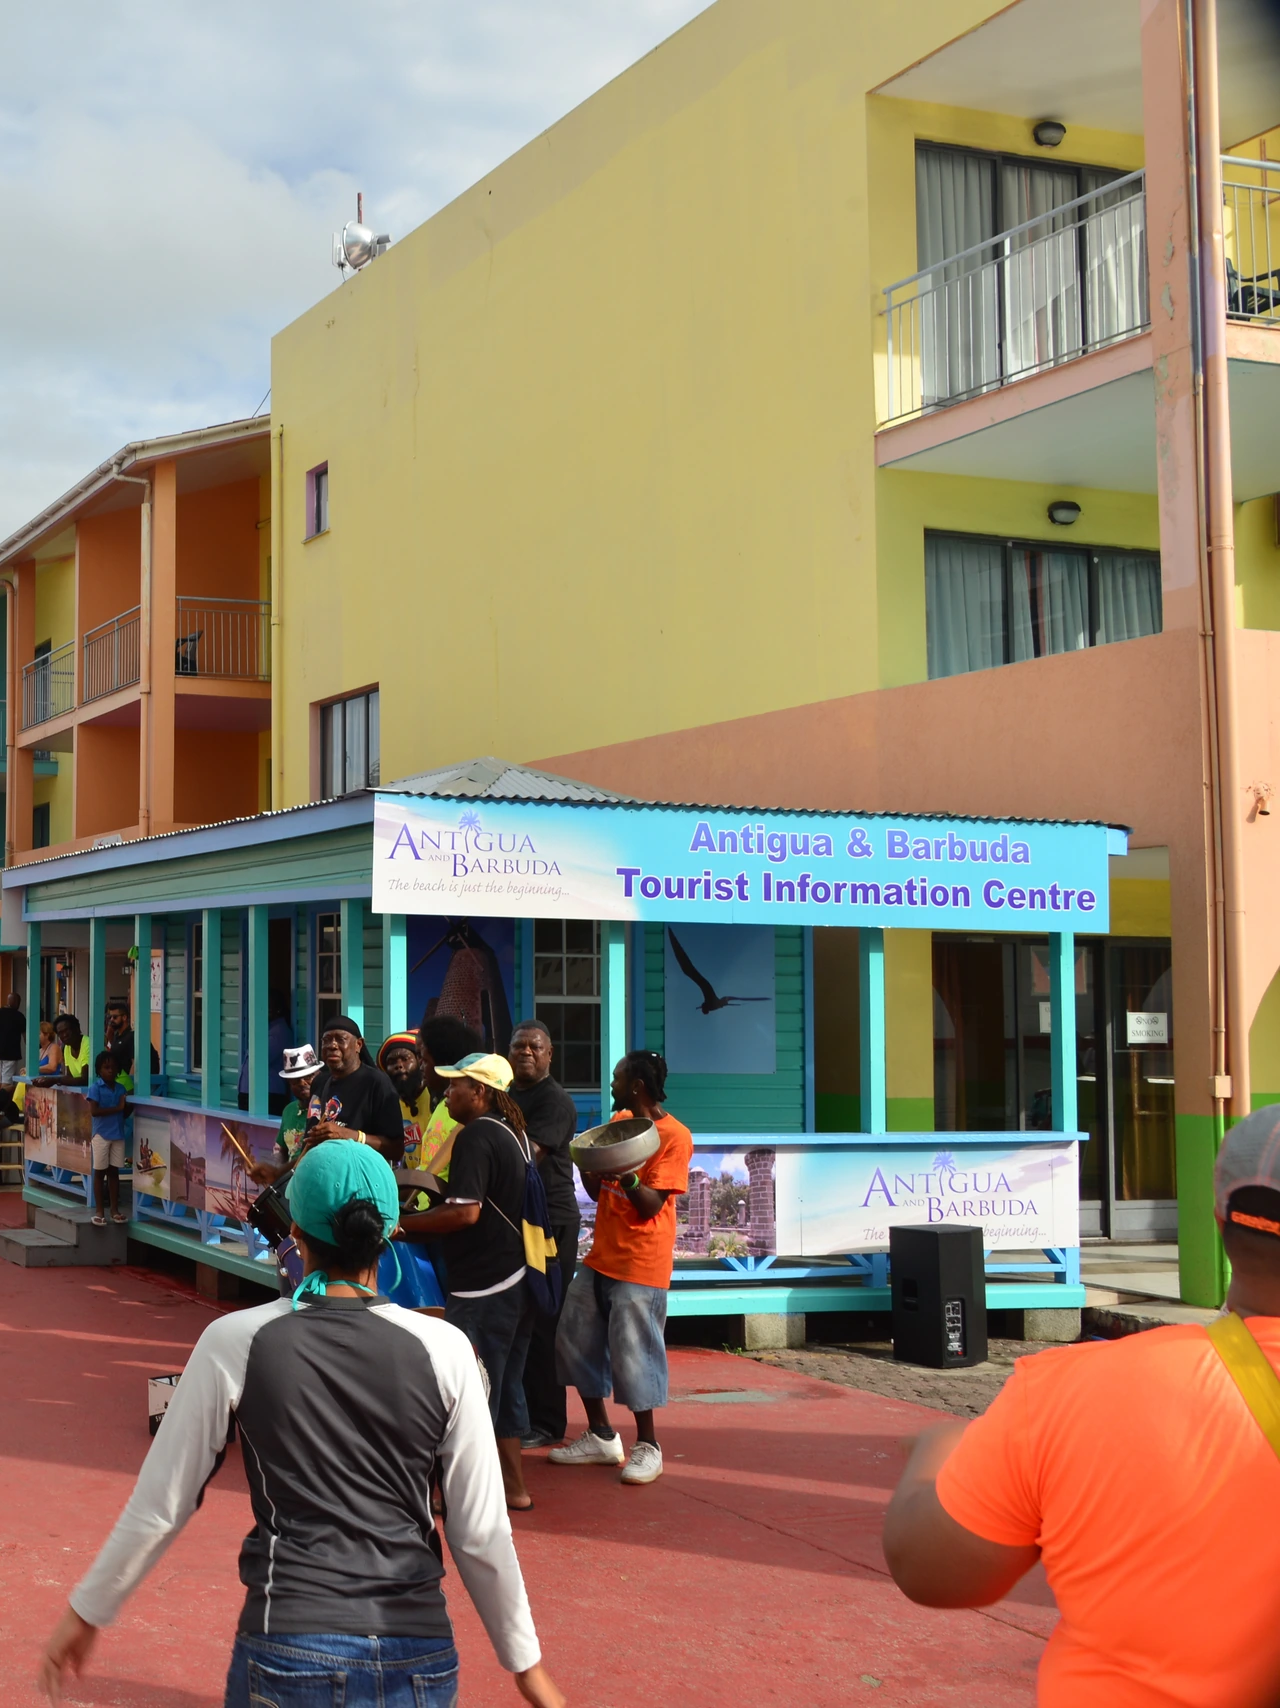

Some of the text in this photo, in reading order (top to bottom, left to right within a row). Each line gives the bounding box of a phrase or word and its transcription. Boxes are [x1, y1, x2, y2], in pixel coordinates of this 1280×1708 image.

[689, 821, 1031, 864] Antigua & Barbuda
[428, 853, 562, 878] AND BARBUDA
[388, 879, 410, 891] The
[413, 879, 447, 892] beach
[449, 881, 459, 892] is
[459, 881, 484, 898] just
[485, 880, 505, 893] the
[616, 867, 1096, 912] Tourist Information Centre
[902, 1196, 1039, 1223] AND BARBUDA
[863, 1228, 886, 1240] The
